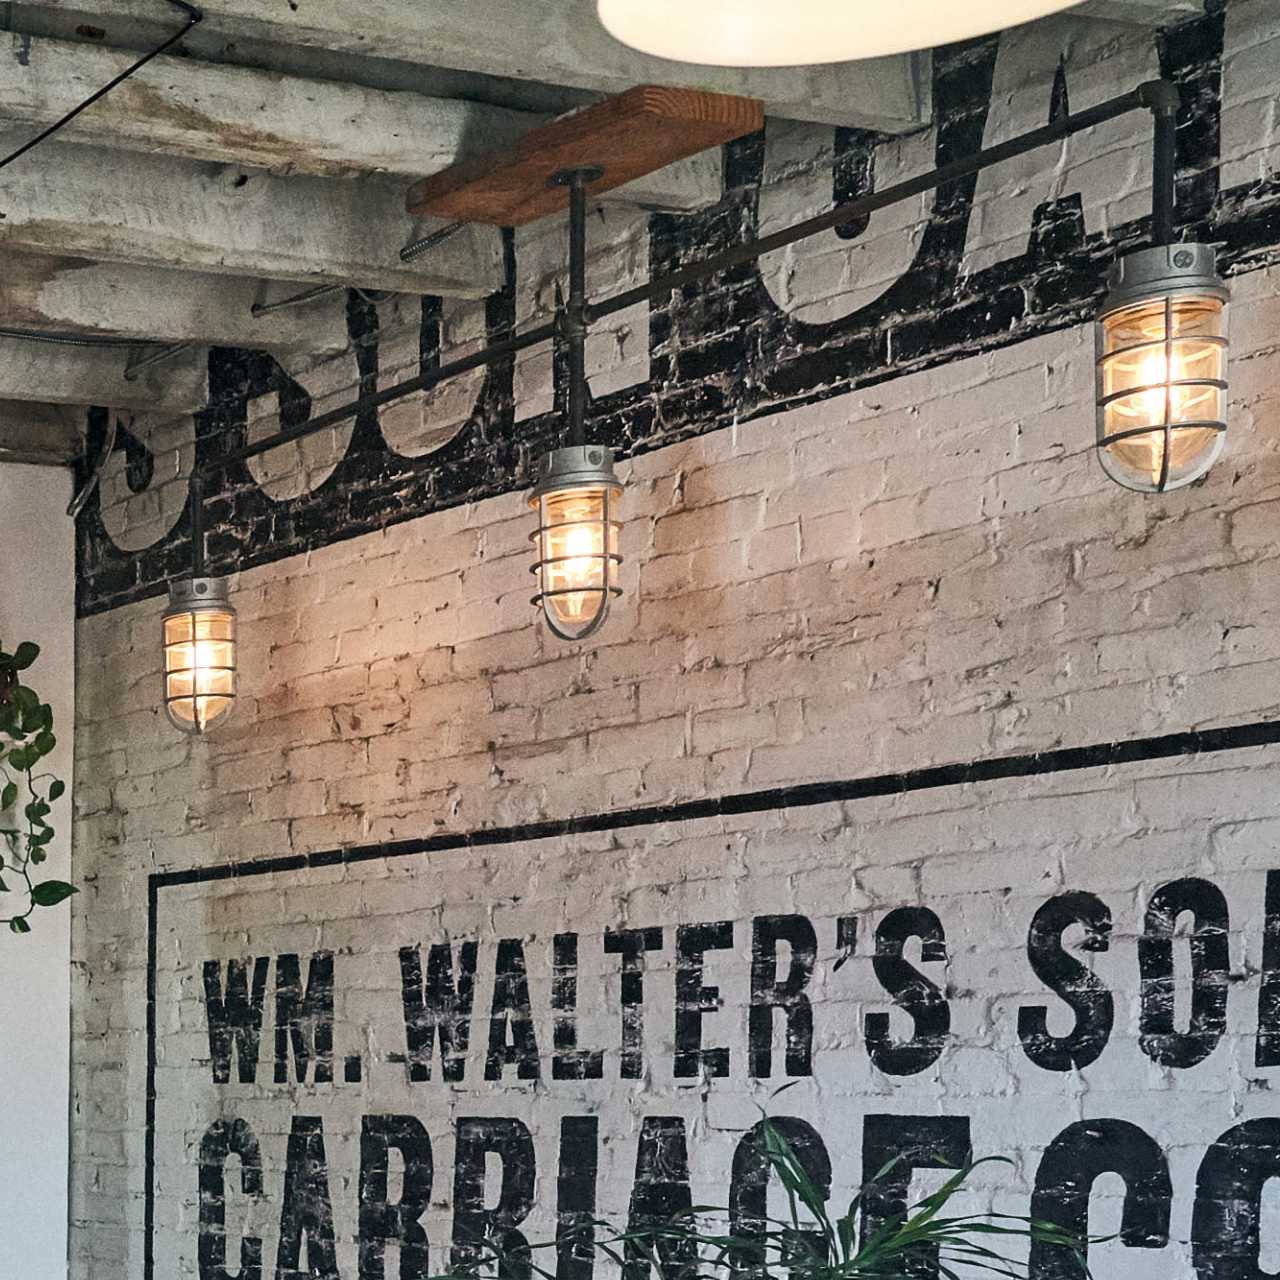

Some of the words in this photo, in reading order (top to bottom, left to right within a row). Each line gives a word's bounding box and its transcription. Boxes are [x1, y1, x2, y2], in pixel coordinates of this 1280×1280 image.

[200, 951, 361, 1084] WM.
[398, 904, 953, 1083] WALTER'S
[1017, 867, 1280, 1072] SO
